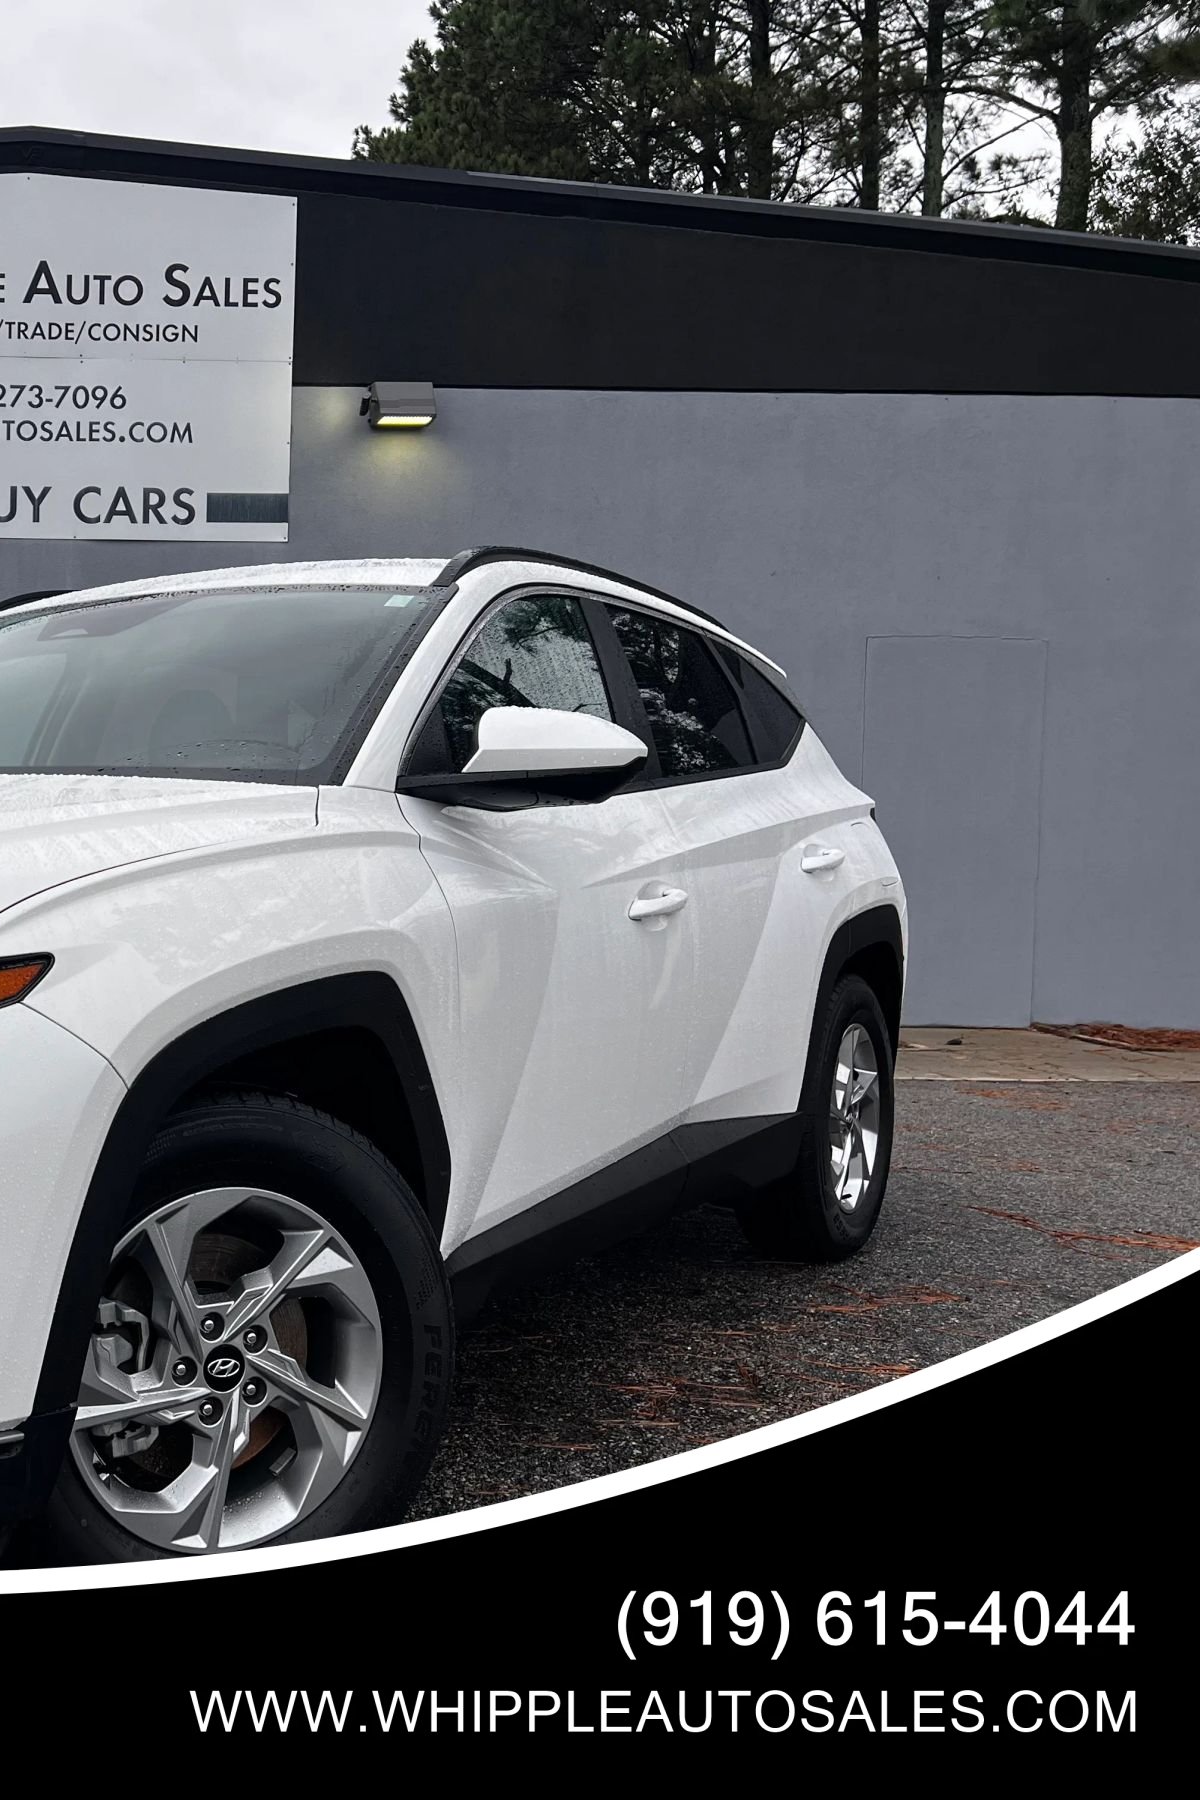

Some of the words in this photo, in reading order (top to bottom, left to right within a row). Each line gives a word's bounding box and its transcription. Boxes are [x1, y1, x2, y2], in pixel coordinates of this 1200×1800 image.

[22, 260, 144, 306] AUTO
[162, 263, 282, 309] SALES
[73, 486, 196, 526] CARS
